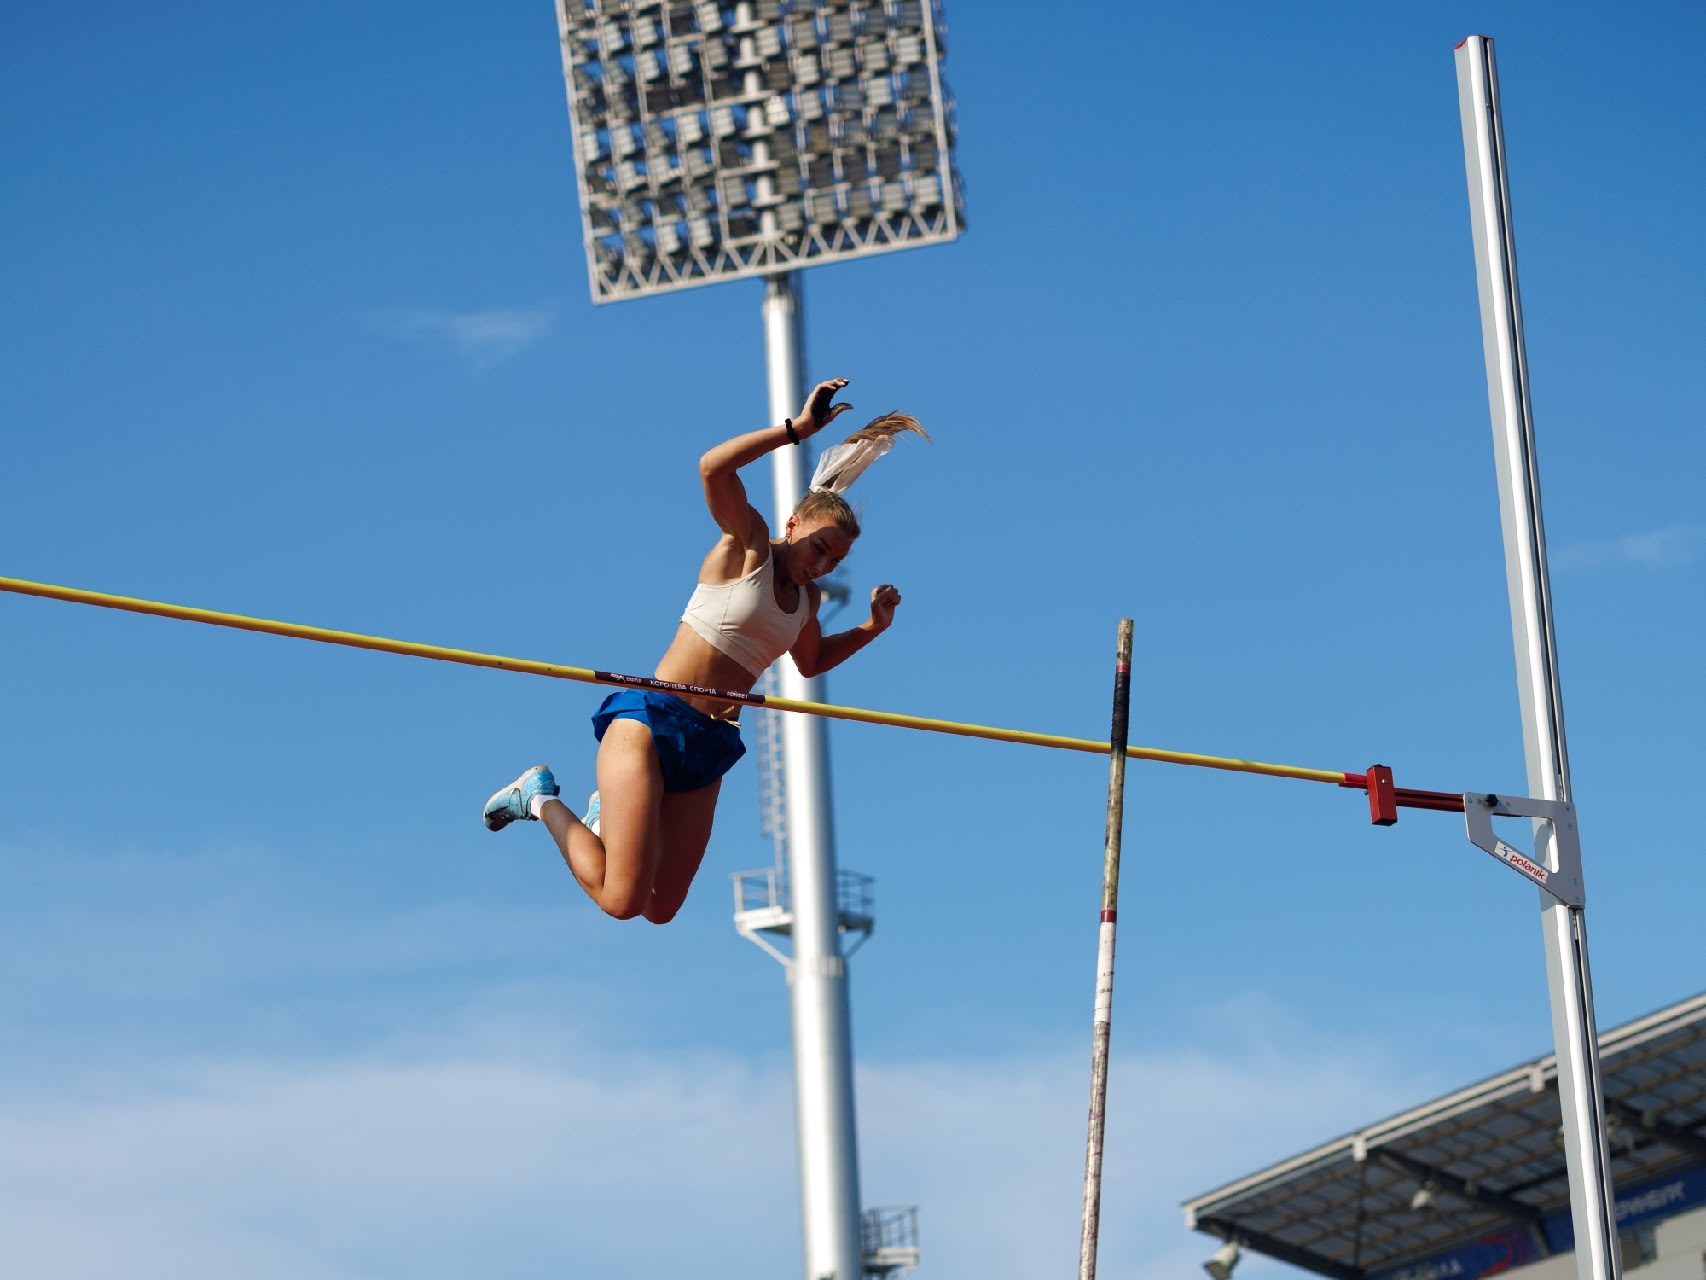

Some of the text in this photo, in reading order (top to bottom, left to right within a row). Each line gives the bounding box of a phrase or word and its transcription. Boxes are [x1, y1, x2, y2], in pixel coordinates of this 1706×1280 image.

[650, 680, 717, 695] КОРОЛЕВА СПОРТА
[1509, 854, 1546, 881] polanik
